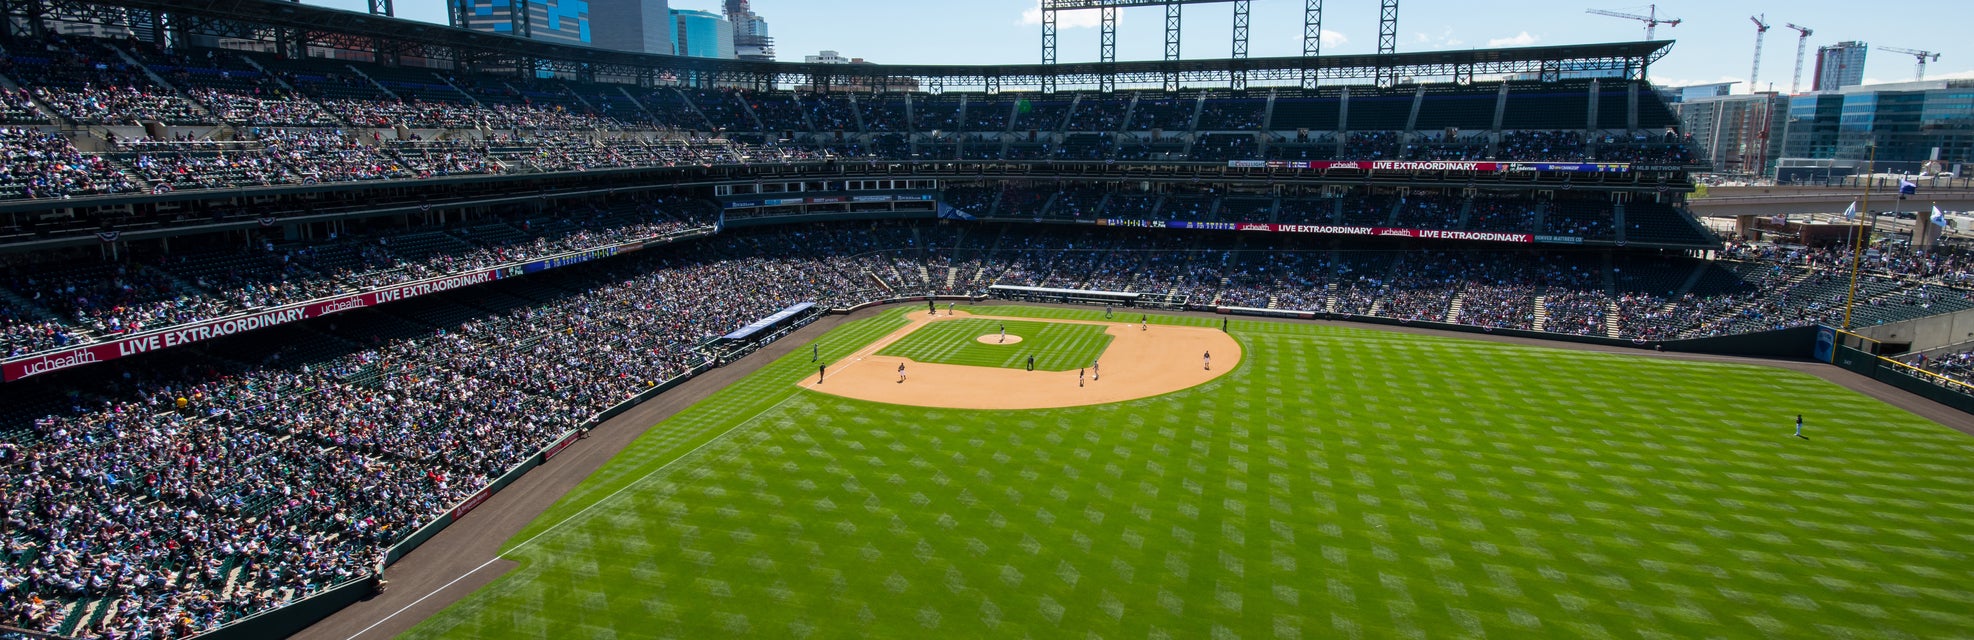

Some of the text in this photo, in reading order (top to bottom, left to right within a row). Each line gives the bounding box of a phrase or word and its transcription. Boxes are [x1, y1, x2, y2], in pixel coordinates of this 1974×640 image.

[1373, 162, 1478, 170] LIVE EXTRAORDINARY.
[1278, 224, 1374, 235] LIVE EXTRAORDINARY.
[1381, 228, 1410, 236] uchealth
[1419, 230, 1528, 242] LIVE EXTRAORDINARY.
[375, 272, 492, 304] LIVE EXTRAORDINARY.
[321, 296, 364, 315] uchealth
[119, 307, 310, 358] LIVE EXTRAORDINARY.
[24, 348, 96, 376] uchealth
